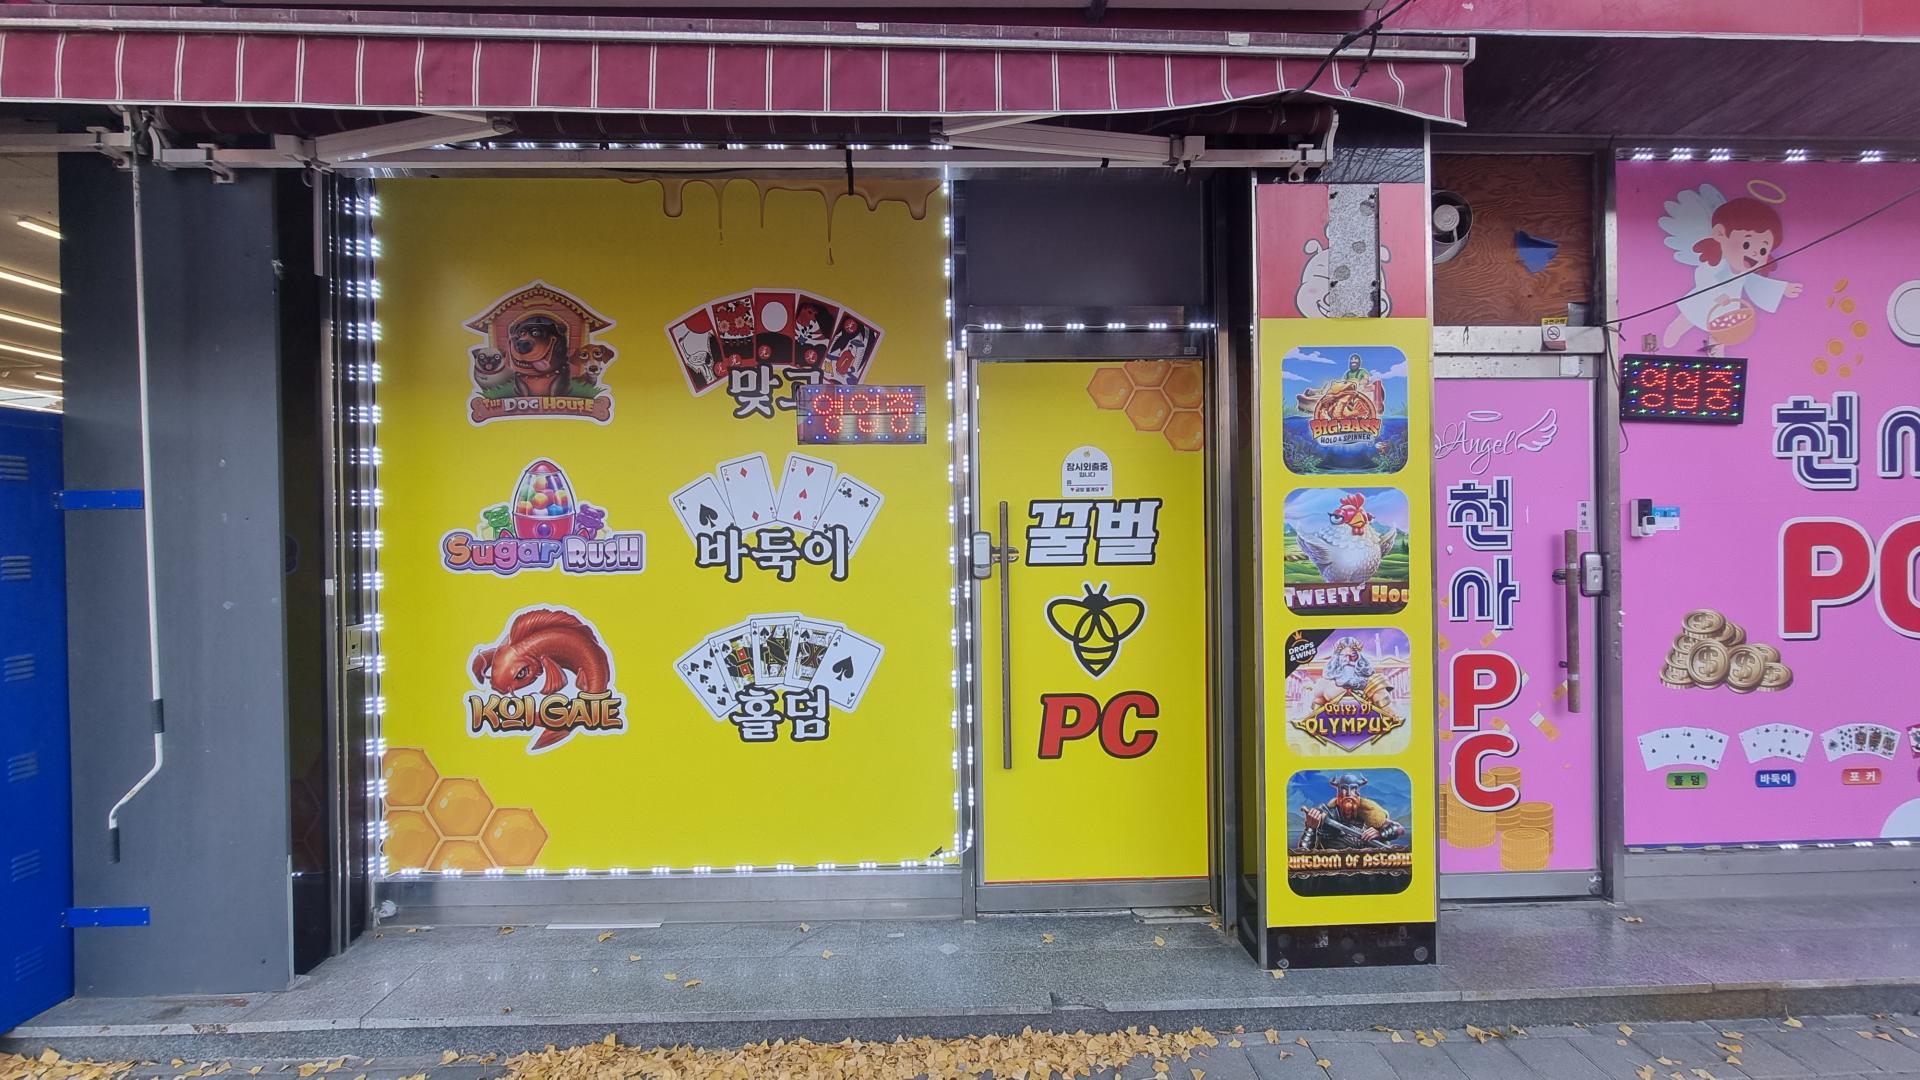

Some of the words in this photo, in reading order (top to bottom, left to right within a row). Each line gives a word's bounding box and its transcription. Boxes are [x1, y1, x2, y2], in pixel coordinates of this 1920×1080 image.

[503, 398, 539, 412] DOG
[1640, 368, 1734, 409] 영업중
[812, 393, 913, 434] 영업중
[1311, 419, 1338, 439] BIG
[1340, 419, 1380, 437] BASS
[1439, 420, 1514, 475] Angel
[444, 534, 563, 571] Sugar
[565, 536, 640, 568] RUSH
[695, 523, 849, 583] 바둑이
[1025, 498, 1164, 567] 꿀벌
[1446, 476, 1521, 631] 천사
[1284, 584, 1367, 607] TWEETY
[1288, 641, 1315, 655] DROPS
[469, 694, 536, 732] KOI
[539, 690, 624, 731] GATE
[728, 683, 830, 742] 홀덤
[1038, 690, 1160, 759] PC
[1305, 717, 1392, 735] OLYMPUS
[1450, 650, 1523, 812] PC
[1759, 773, 1792, 785] 바둑이
